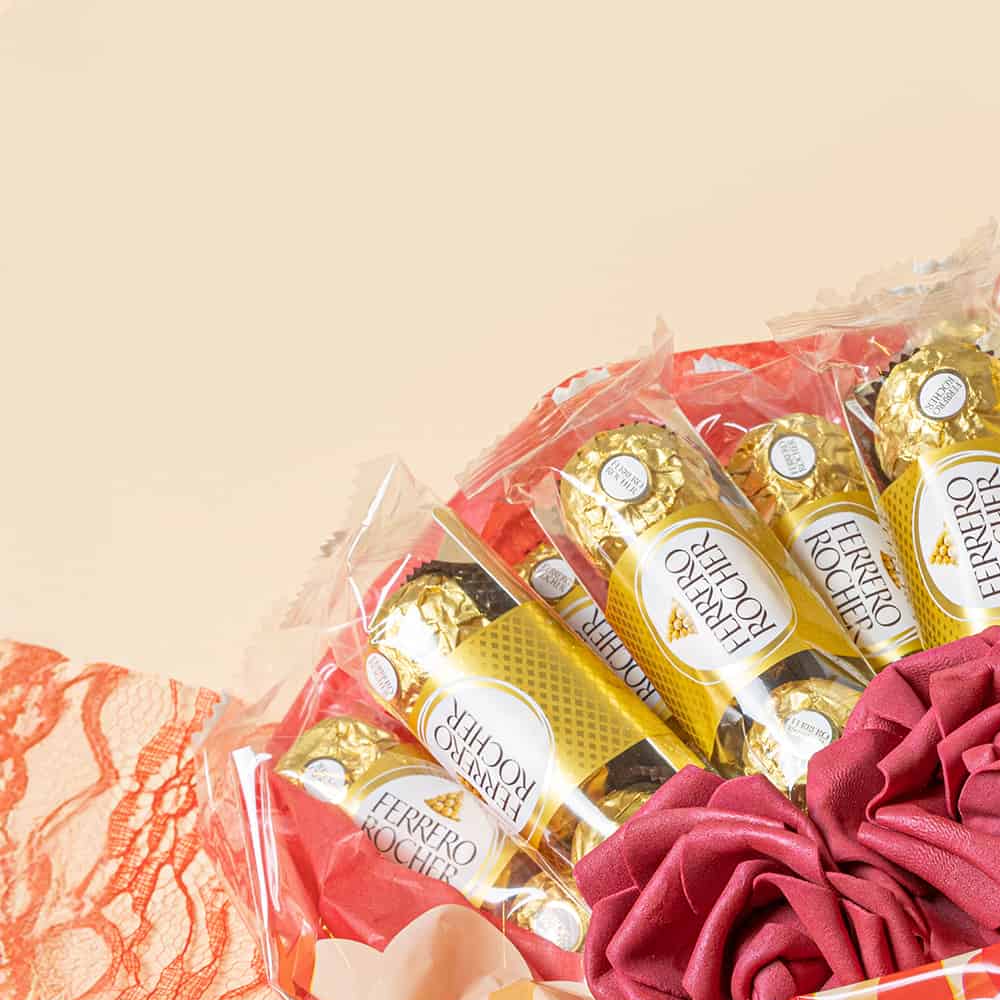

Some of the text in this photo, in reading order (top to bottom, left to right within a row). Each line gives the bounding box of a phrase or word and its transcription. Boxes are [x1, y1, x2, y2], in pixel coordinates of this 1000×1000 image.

[665, 549, 751, 654] FERRERO
[690, 530, 777, 638] ROCHER
[832, 519, 902, 627] FERRERO
[434, 725, 522, 822] FERRERO
[446, 696, 537, 803] ROCHER
[361, 815, 459, 884] ROCHER
[371, 792, 477, 866] FERRERO
